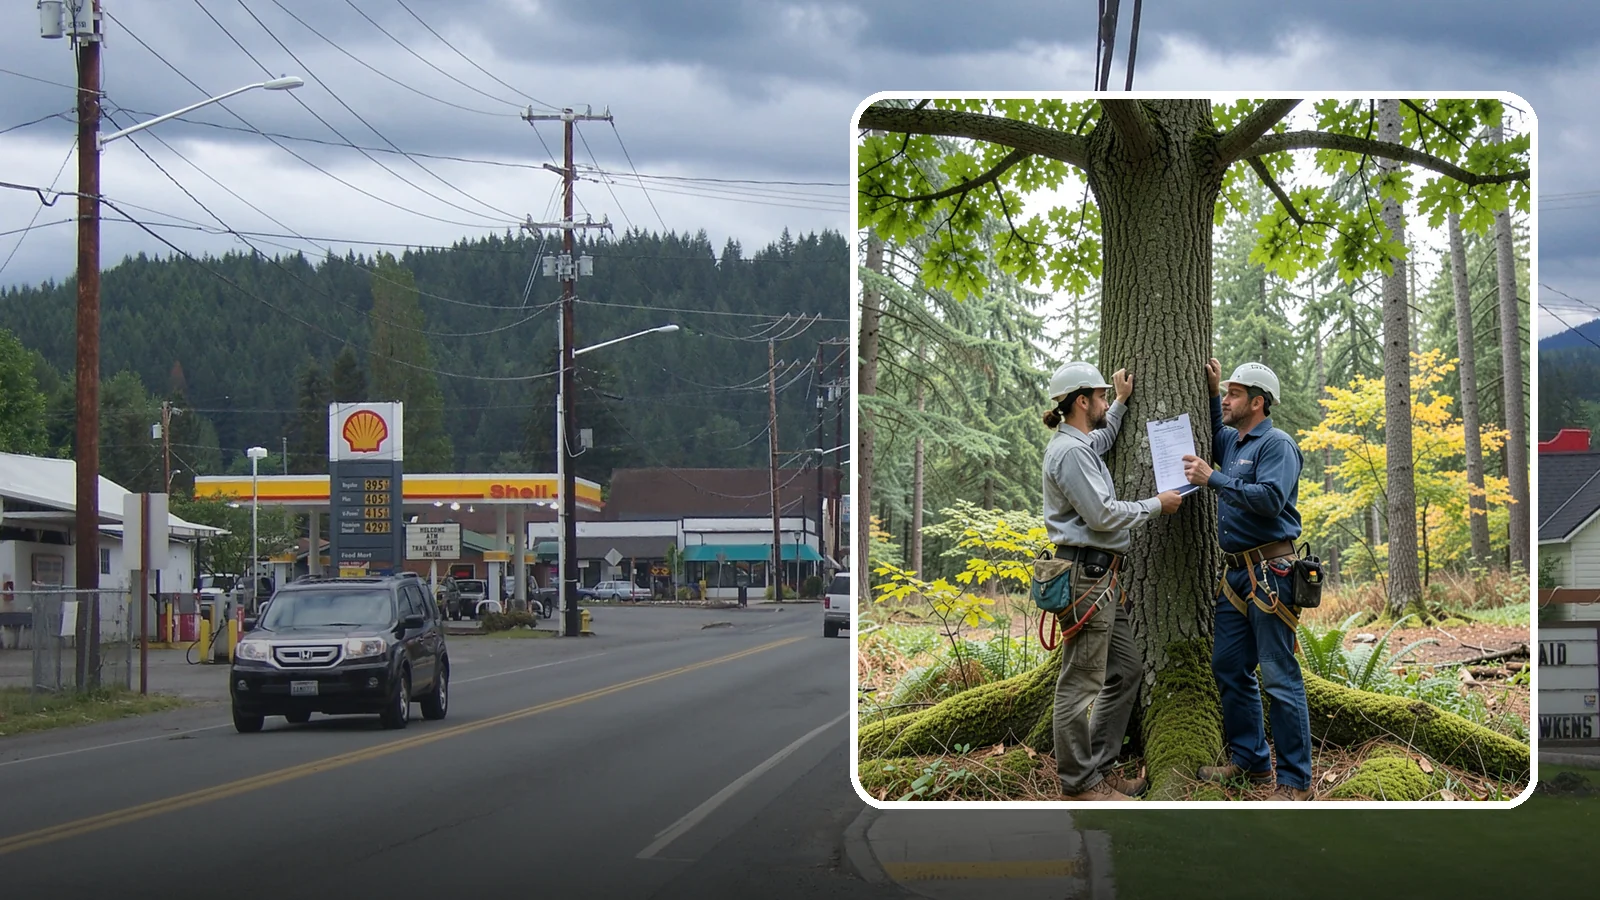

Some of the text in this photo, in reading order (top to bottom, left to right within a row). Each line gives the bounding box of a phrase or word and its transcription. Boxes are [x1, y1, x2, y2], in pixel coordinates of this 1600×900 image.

[366, 480, 384, 490] 395
[490, 484, 547, 499] Shell
[365, 494, 384, 504] 405
[365, 508, 384, 518] 415
[366, 522, 384, 532] 429
